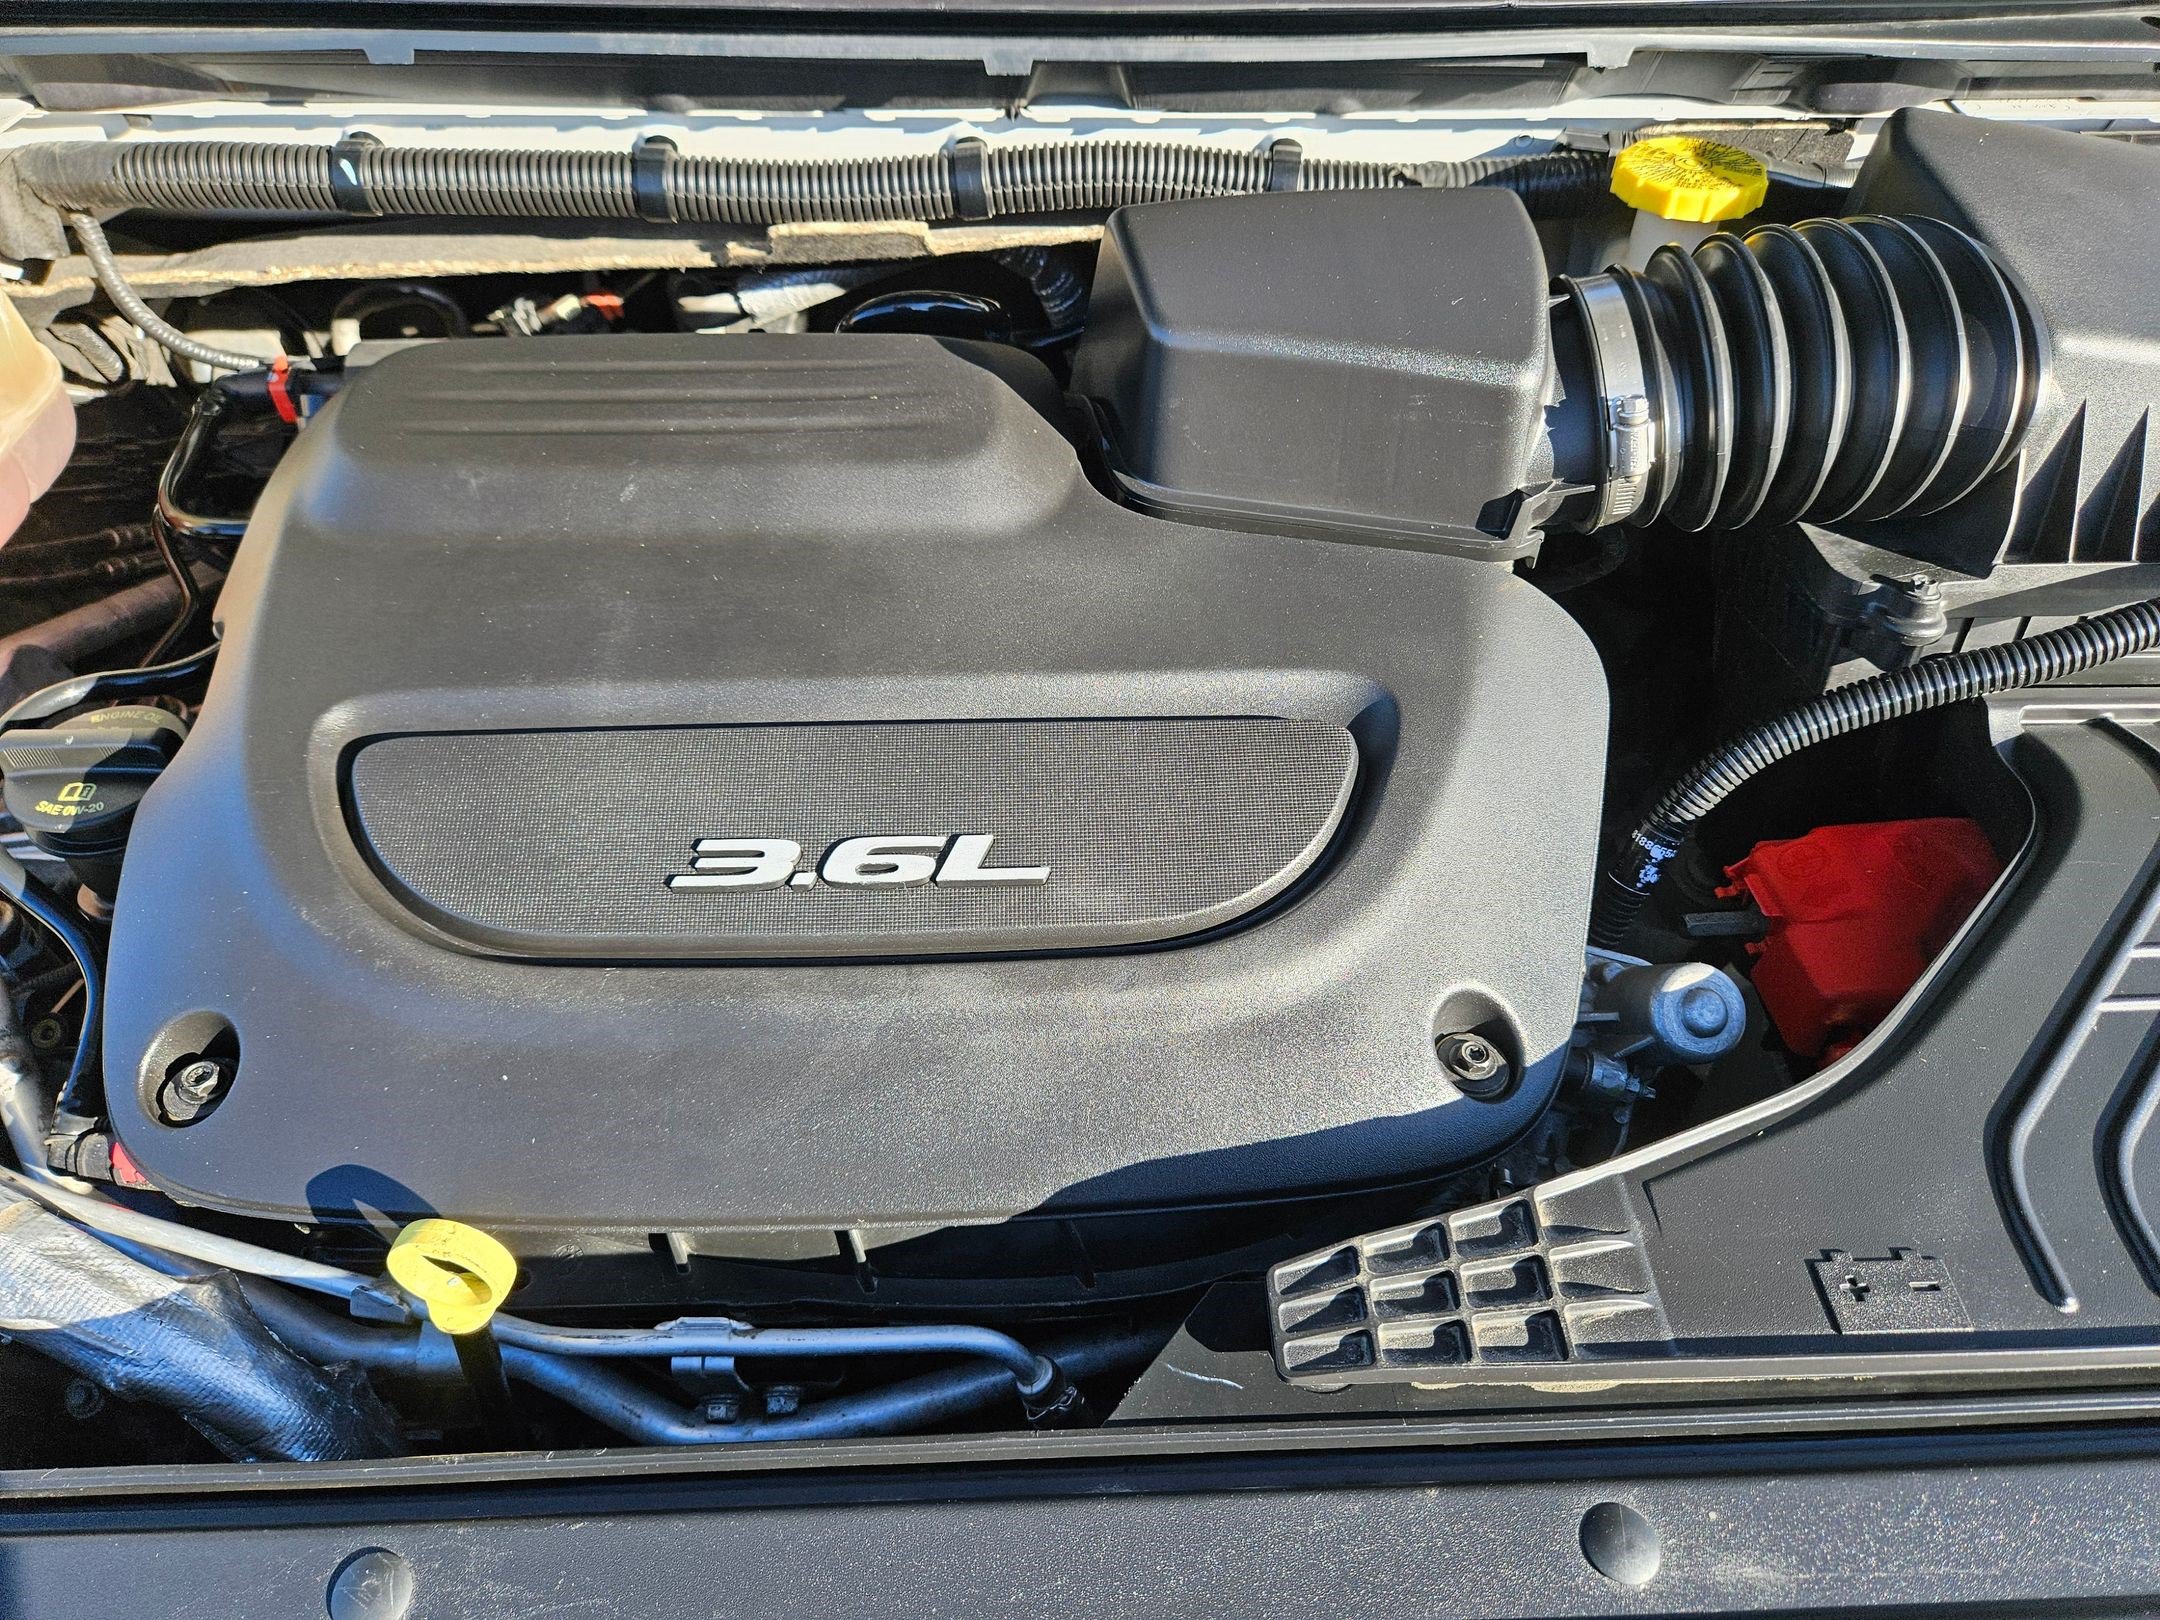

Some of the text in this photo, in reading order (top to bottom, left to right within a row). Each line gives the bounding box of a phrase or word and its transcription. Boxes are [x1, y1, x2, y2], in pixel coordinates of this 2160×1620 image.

[91, 711, 144, 724] ENGINE
[35, 800, 104, 816] SAE 0W-20
[667, 834, 1052, 894] 3.6L
